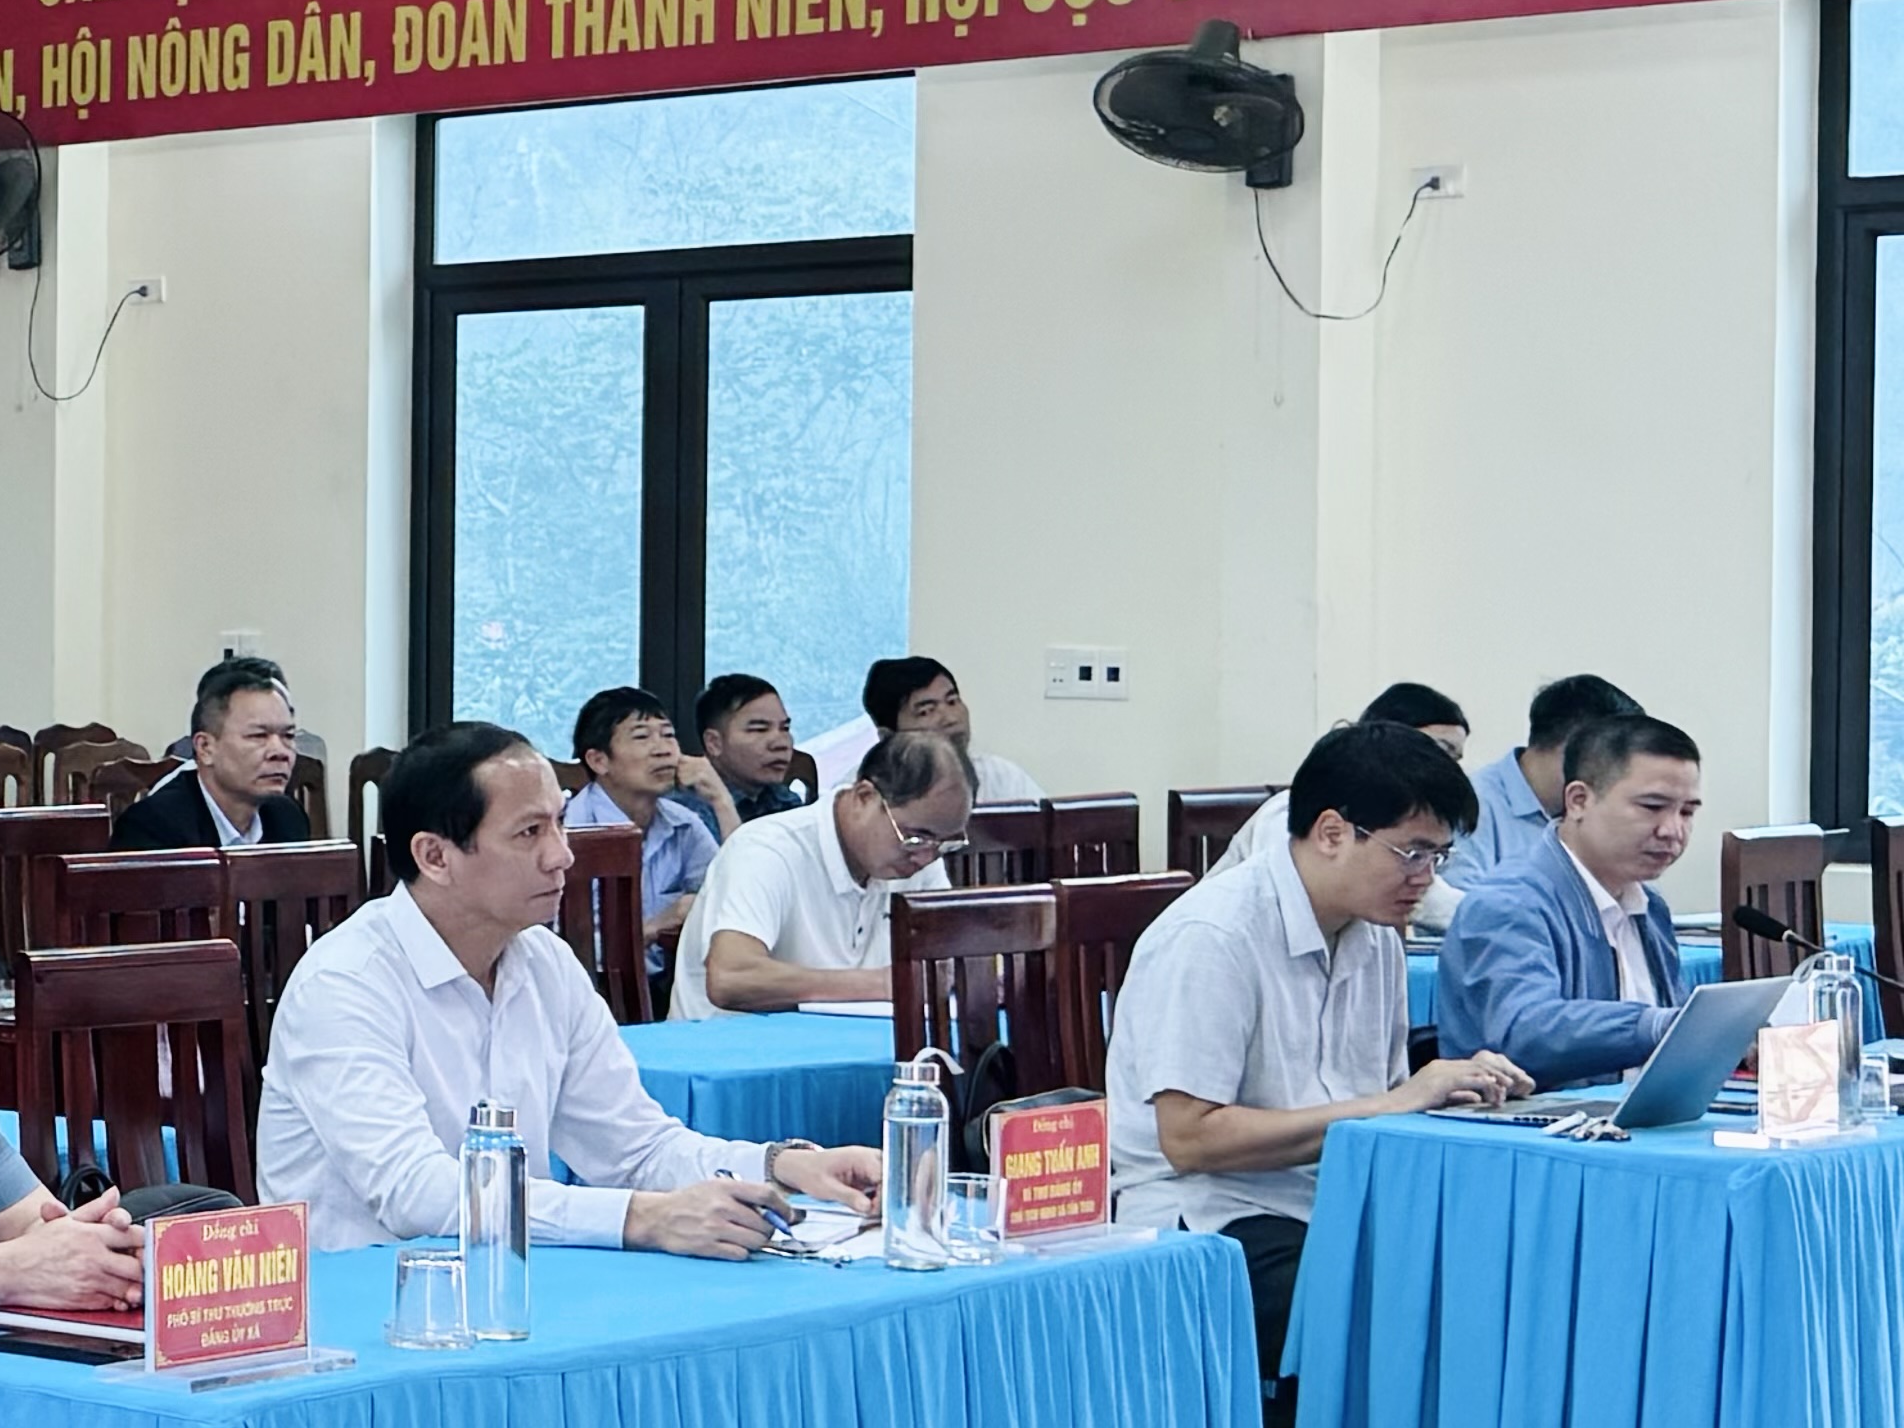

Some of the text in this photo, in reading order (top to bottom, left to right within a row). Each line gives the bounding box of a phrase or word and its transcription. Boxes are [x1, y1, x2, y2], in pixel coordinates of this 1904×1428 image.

[41, 28, 112, 118] HỘI
[126, 20, 250, 99] NÔNG
[266, 1, 376, 87] DÂN,
[162, 1255, 218, 1301] HOÀNG
[222, 1249, 255, 1292] VĂN
